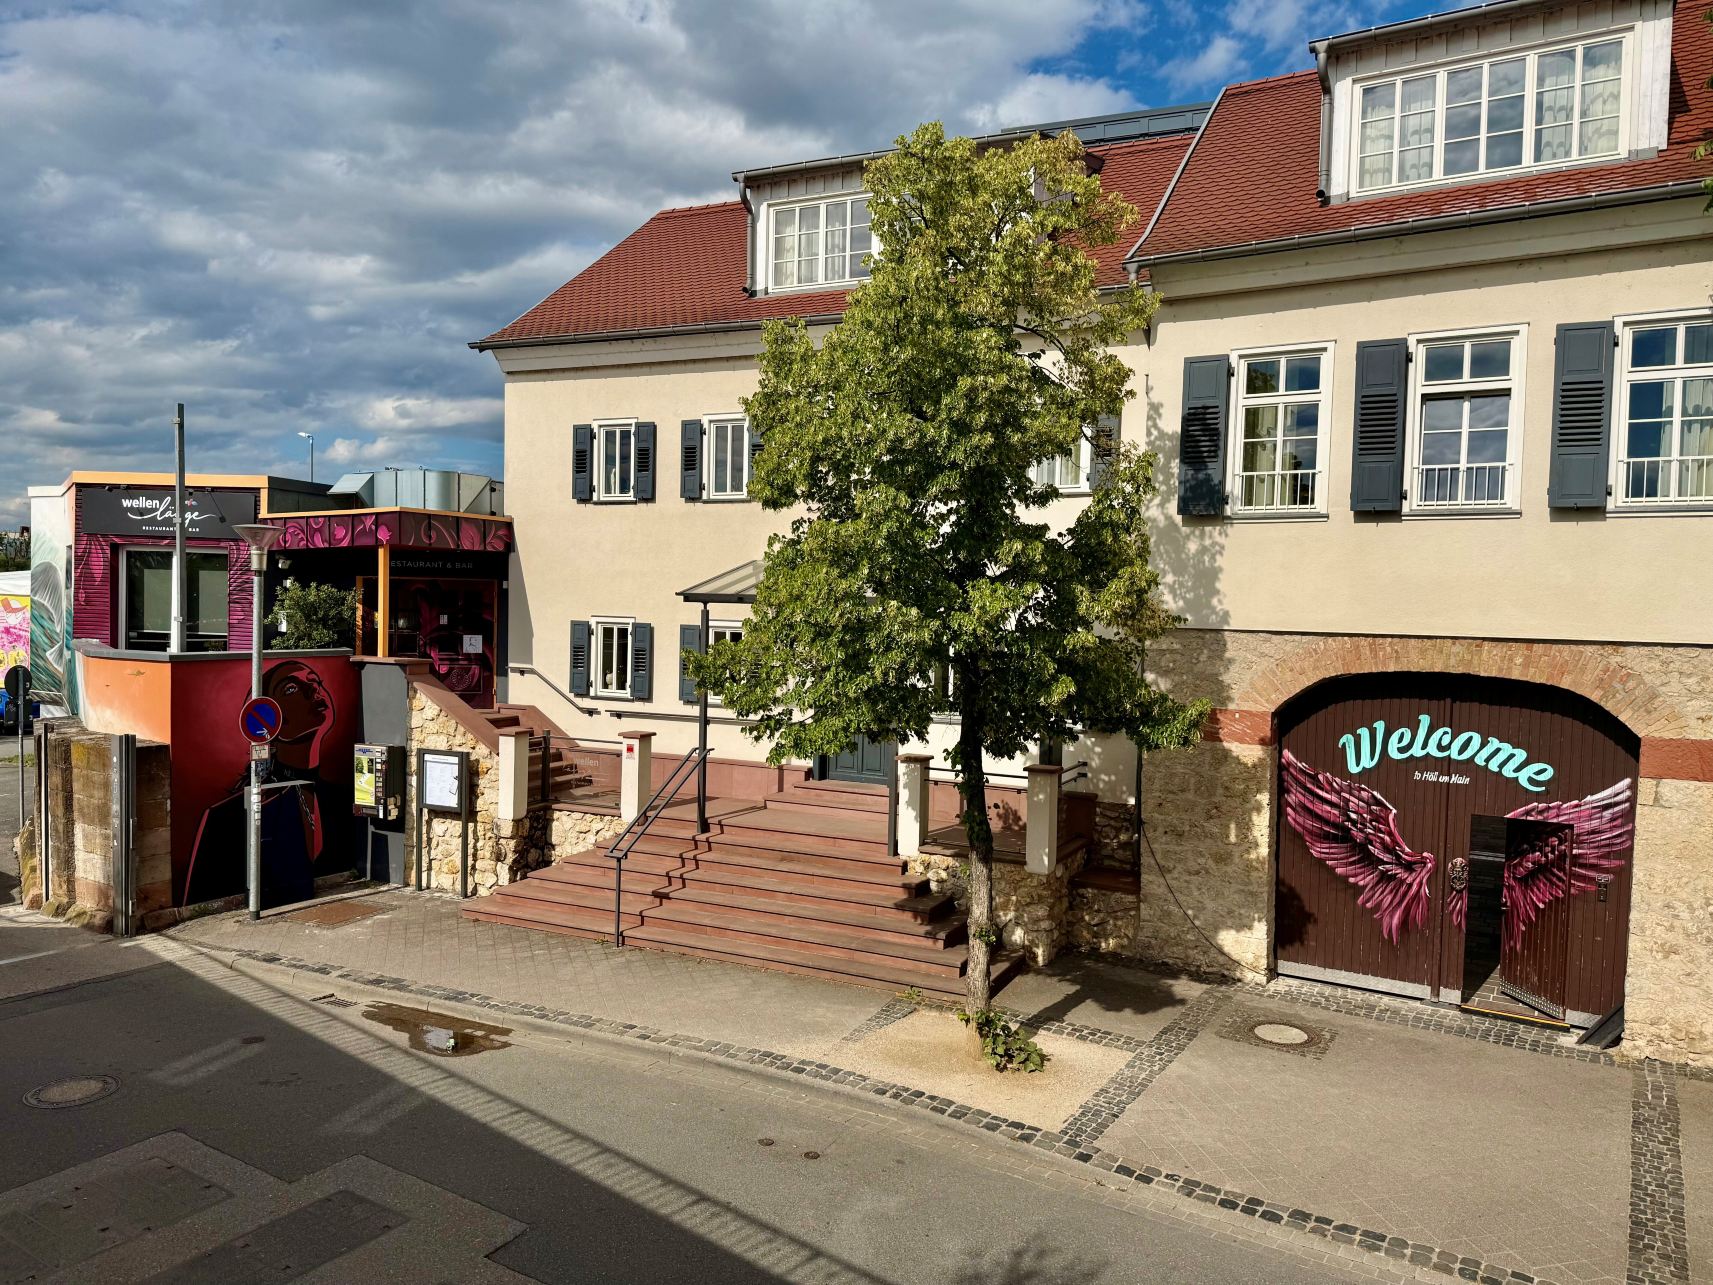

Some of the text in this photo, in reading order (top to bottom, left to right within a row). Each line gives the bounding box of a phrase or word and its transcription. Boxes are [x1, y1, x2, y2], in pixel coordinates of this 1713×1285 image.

[122, 497, 160, 509] wellen
[128, 496, 216, 527] läge
[390, 560, 442, 569] ESTAURANT
[1338, 714, 1554, 792] Welcome
[1413, 771, 1421, 780] to
[1422, 771, 1439, 782] Höll
[1450, 774, 1470, 785] Main
